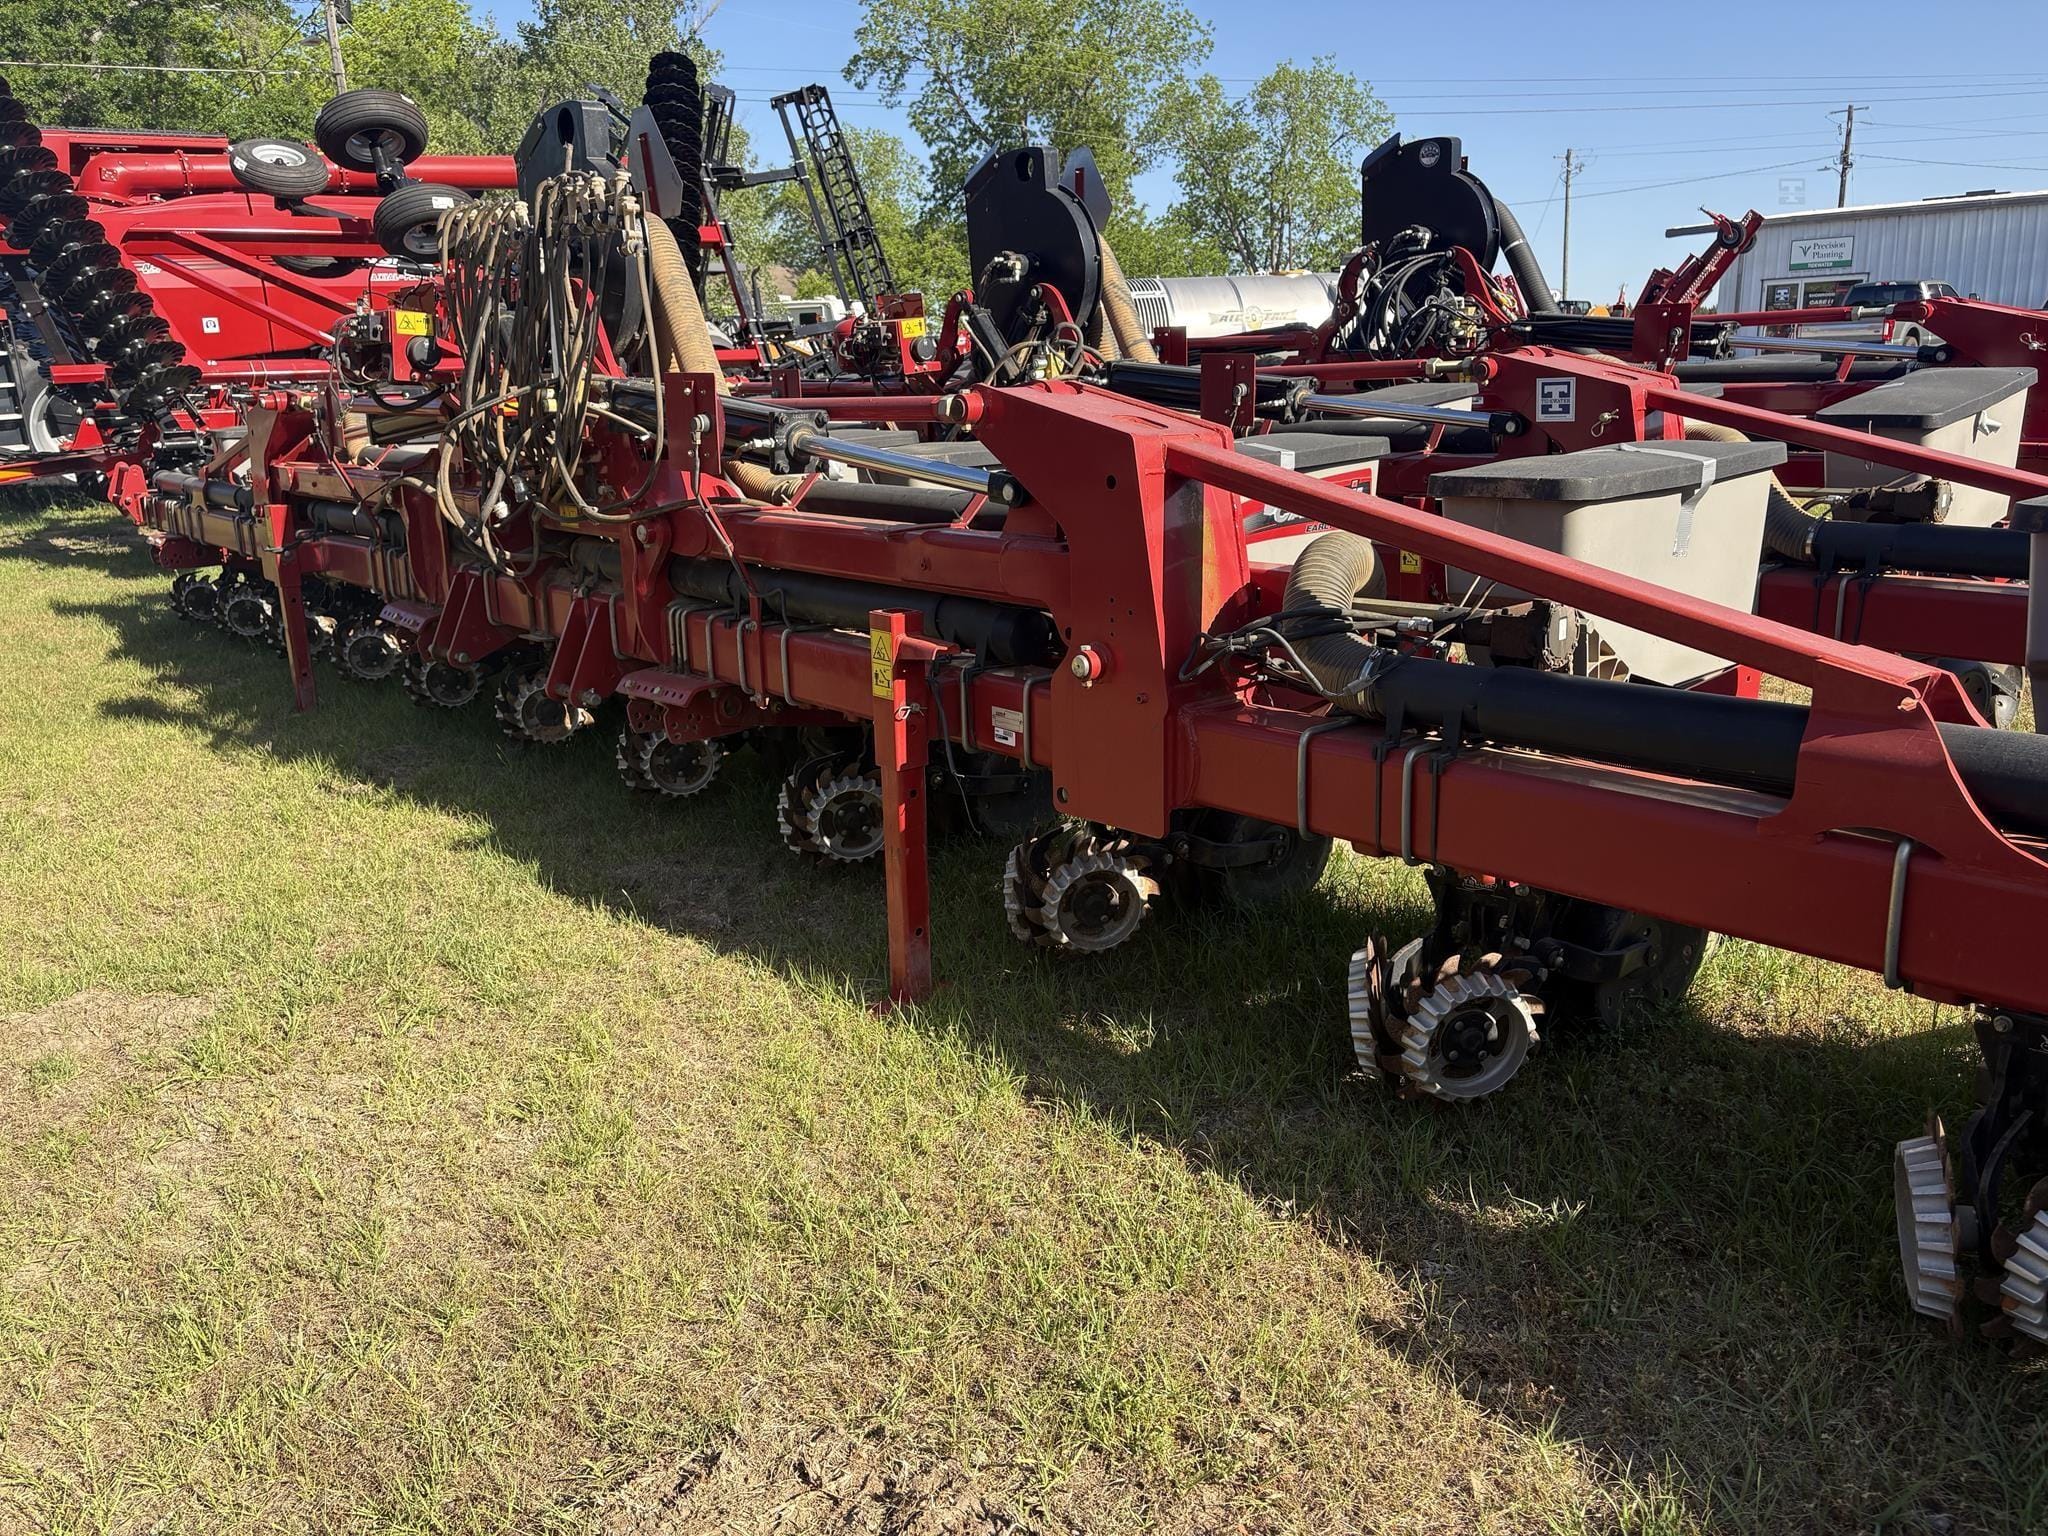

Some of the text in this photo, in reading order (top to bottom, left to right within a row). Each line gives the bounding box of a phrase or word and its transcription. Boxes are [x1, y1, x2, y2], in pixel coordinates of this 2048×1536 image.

[1813, 241, 1846, 250] Precision
[1812, 250, 1844, 259] Planting
[1305, 523, 1334, 533] EARL
